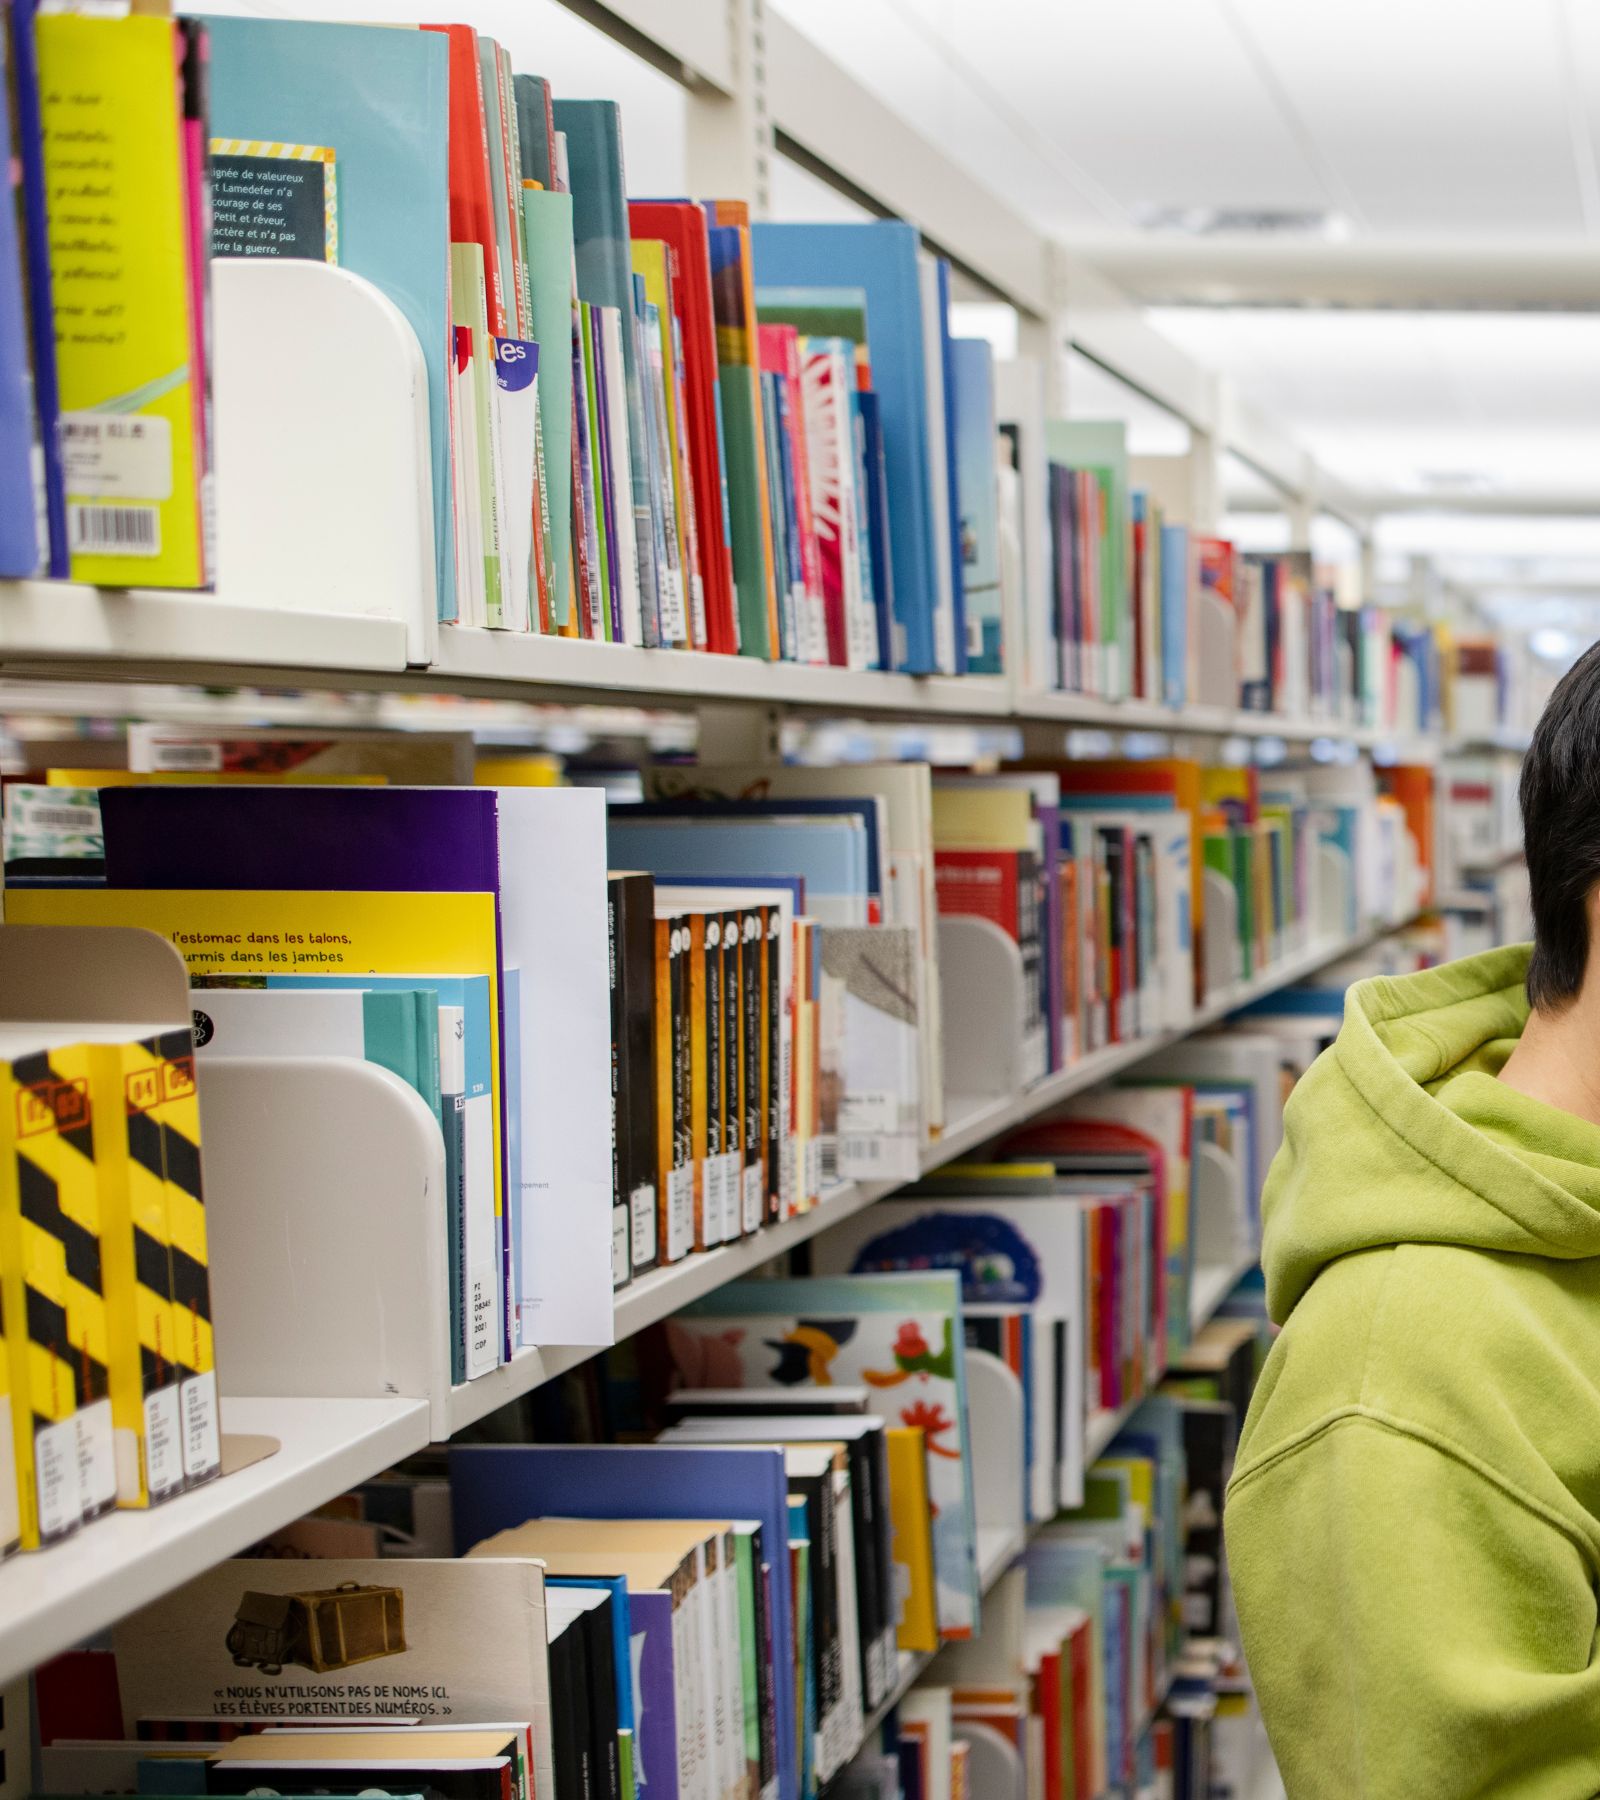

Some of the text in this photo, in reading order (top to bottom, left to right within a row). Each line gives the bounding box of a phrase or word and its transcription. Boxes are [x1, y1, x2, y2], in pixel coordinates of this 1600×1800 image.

[242, 170, 253, 178] de
[257, 172, 303, 183] valeureux
[223, 184, 273, 195] Lamedefer
[212, 199, 249, 209] courage
[252, 201, 264, 209] de
[214, 212, 286, 226] Petit et rêveur,
[248, 229, 257, 238] et
[280, 233, 295, 241] pas
[234, 243, 242, 251] la
[245, 245, 280, 254] guerre.
[492, 271, 501, 304] BAIN
[538, 452, 550, 534] TARZANETTE
[172, 931, 352, 946] l'estomac dans les talons,
[231, 950, 262, 962] dans
[269, 950, 288, 962] les
[292, 950, 343, 964] jambes
[474, 1283, 481, 1291] PZ
[474, 1293, 482, 1301] 23
[474, 1323, 487, 1333] 2021
[227, 1686, 262, 1698] NOUS
[266, 1686, 344, 1698] N'UTILISONS
[348, 1686, 370, 1698] PAS
[375, 1686, 389, 1697] DE
[393, 1686, 428, 1698] NOMS
[432, 1687, 450, 1699] ICI.
[214, 1702, 236, 1714] LES
[240, 1700, 285, 1714] ÉLÈVES
[289, 1702, 346, 1714] PORTENT
[350, 1702, 371, 1714] DES
[376, 1700, 440, 1715] NUMÉROS.
